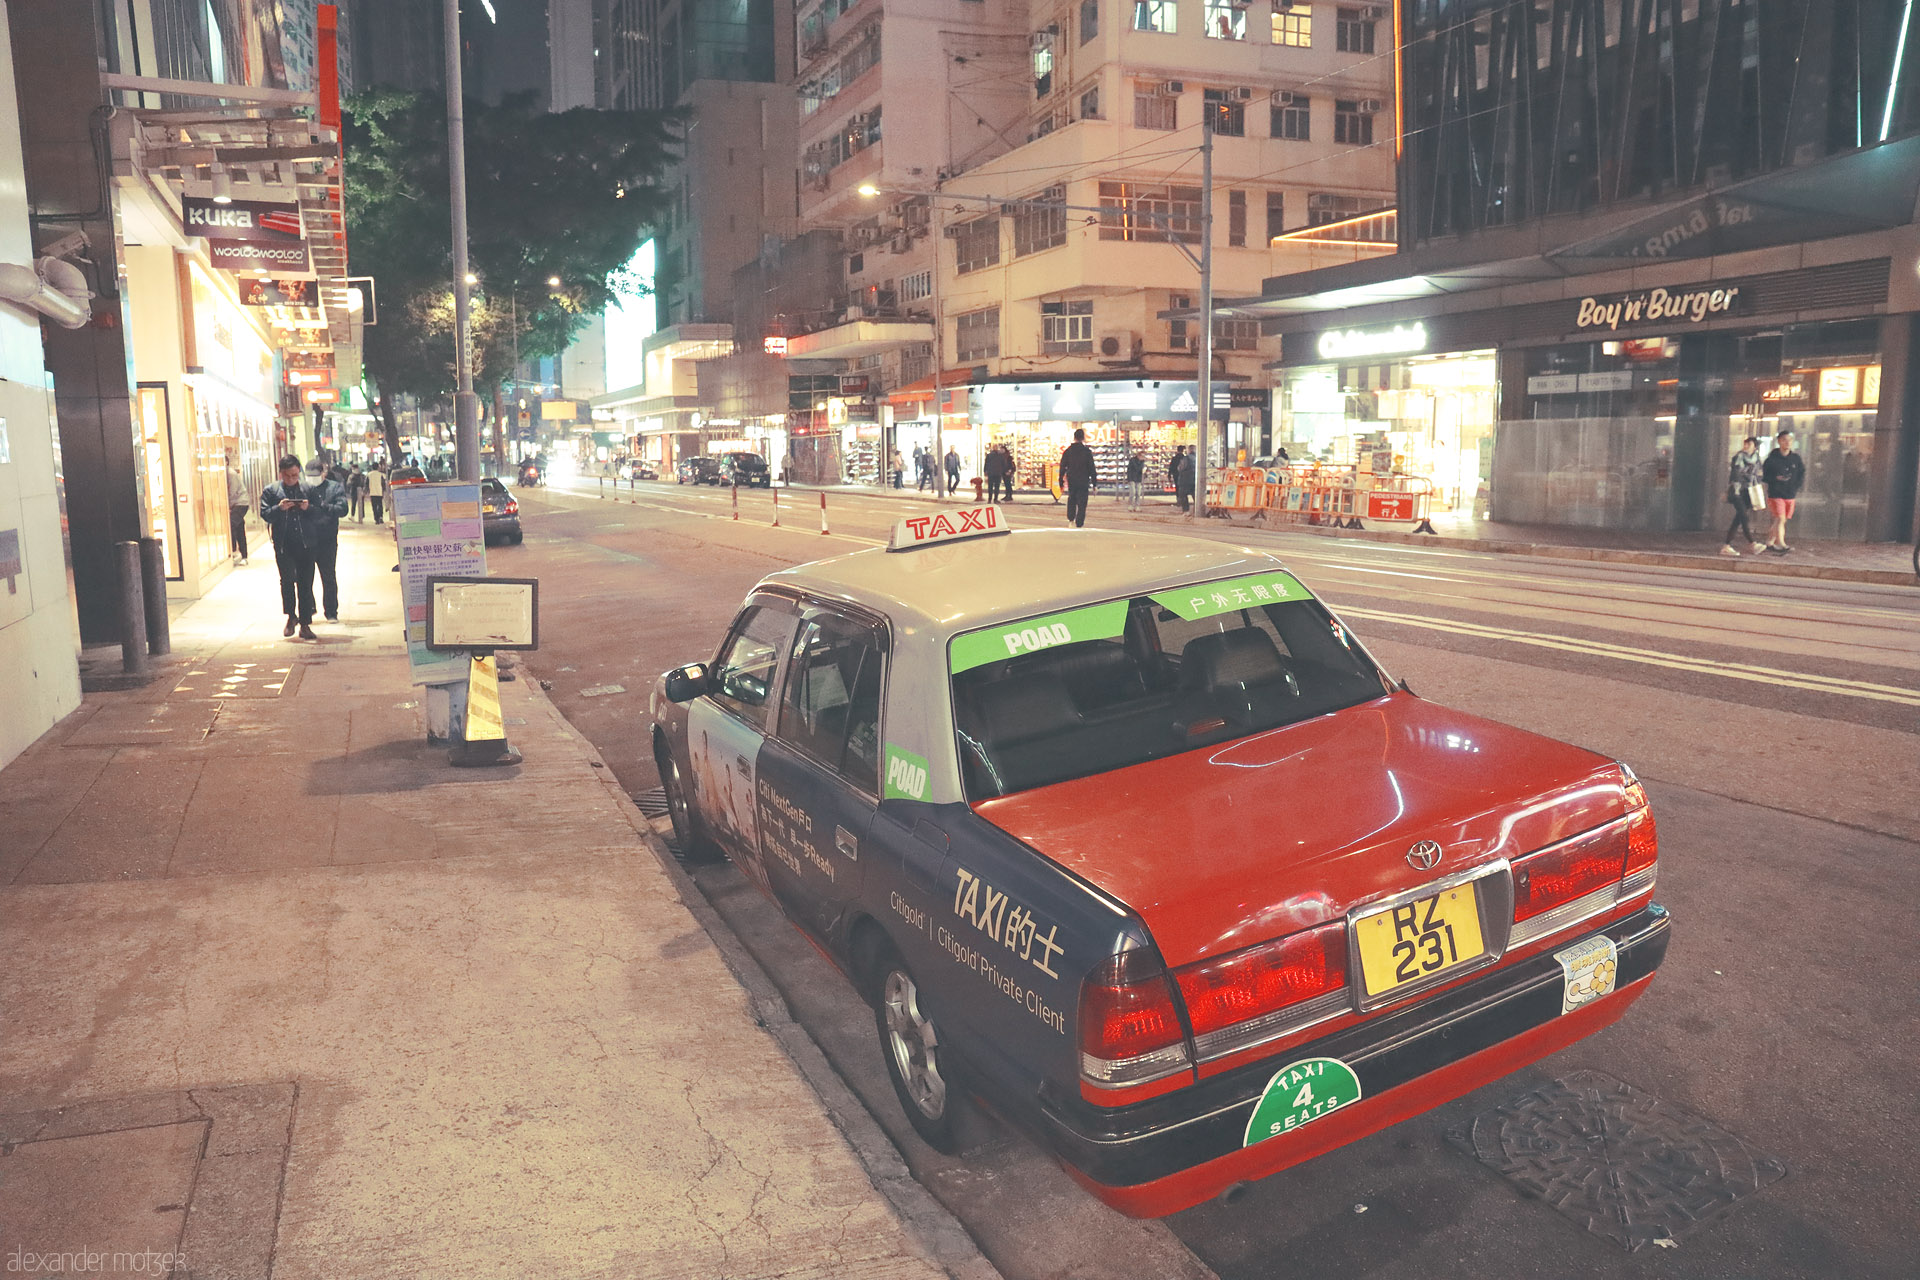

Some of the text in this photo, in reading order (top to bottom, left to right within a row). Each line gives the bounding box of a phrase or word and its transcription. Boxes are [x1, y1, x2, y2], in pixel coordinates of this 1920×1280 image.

[1370, 493, 1412, 501] PEDESTRIANS
[1381, 508, 1400, 519] 行人
[905, 506, 997, 540] TAXI
[1003, 622, 1072, 655] POAD
[887, 755, 927, 799] POAD
[1392, 893, 1445, 942] RZ
[1392, 924, 1458, 983] 231
[980, 956, 1023, 1004] Private
[1026, 990, 1065, 1035] Client
[1277, 1062, 1324, 1091] TAXI
[1292, 1082, 1315, 1108] 4
[1270, 1096, 1338, 1134] SEATS
